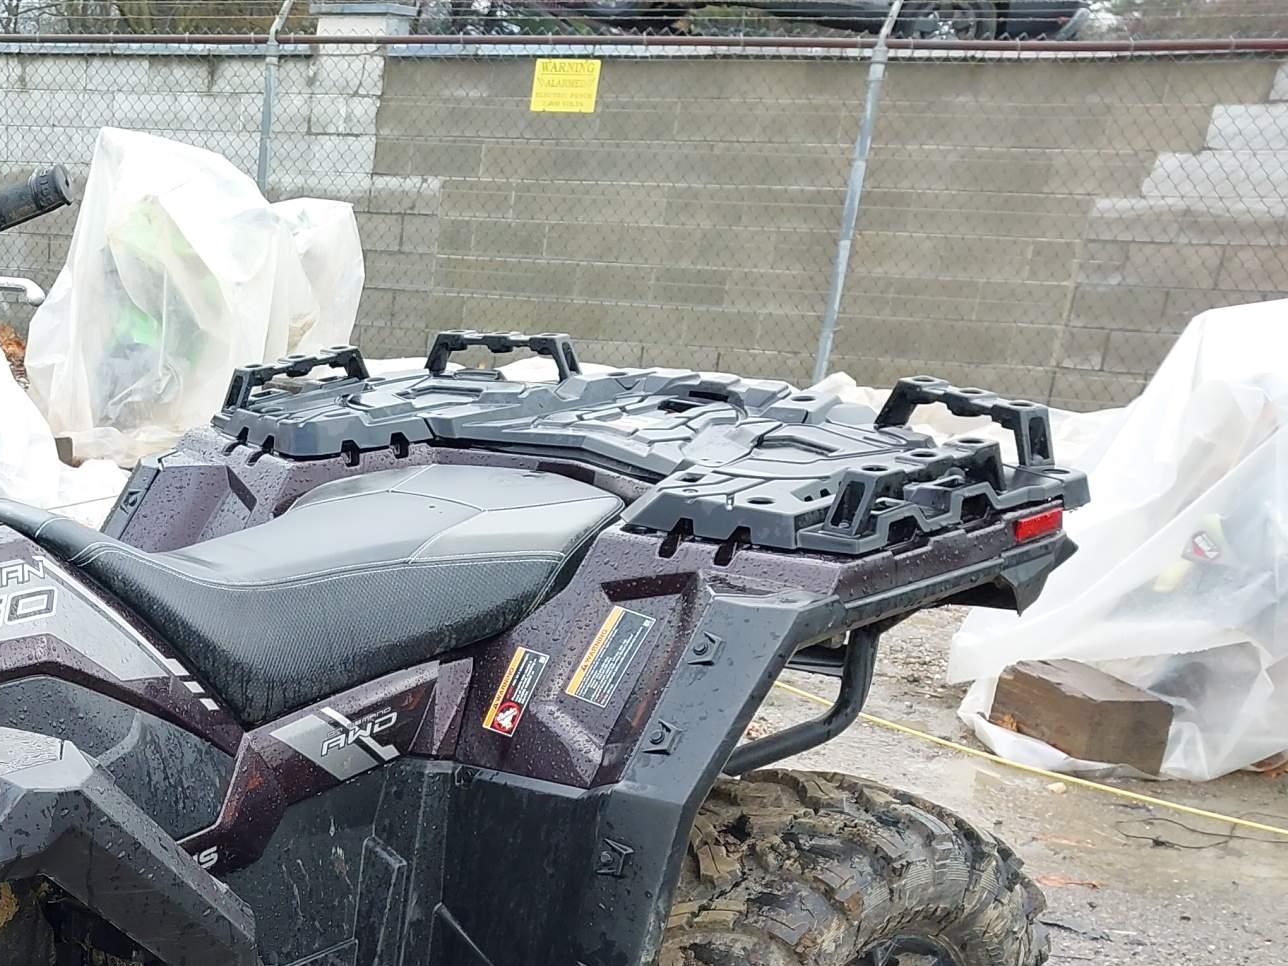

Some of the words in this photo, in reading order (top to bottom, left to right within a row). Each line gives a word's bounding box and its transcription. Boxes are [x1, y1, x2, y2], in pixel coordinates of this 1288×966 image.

[541, 61, 596, 73] WARNING
[584, 628, 608, 664] WARNING
[495, 666, 515, 702] WARNING
[320, 711, 398, 758] AWD
